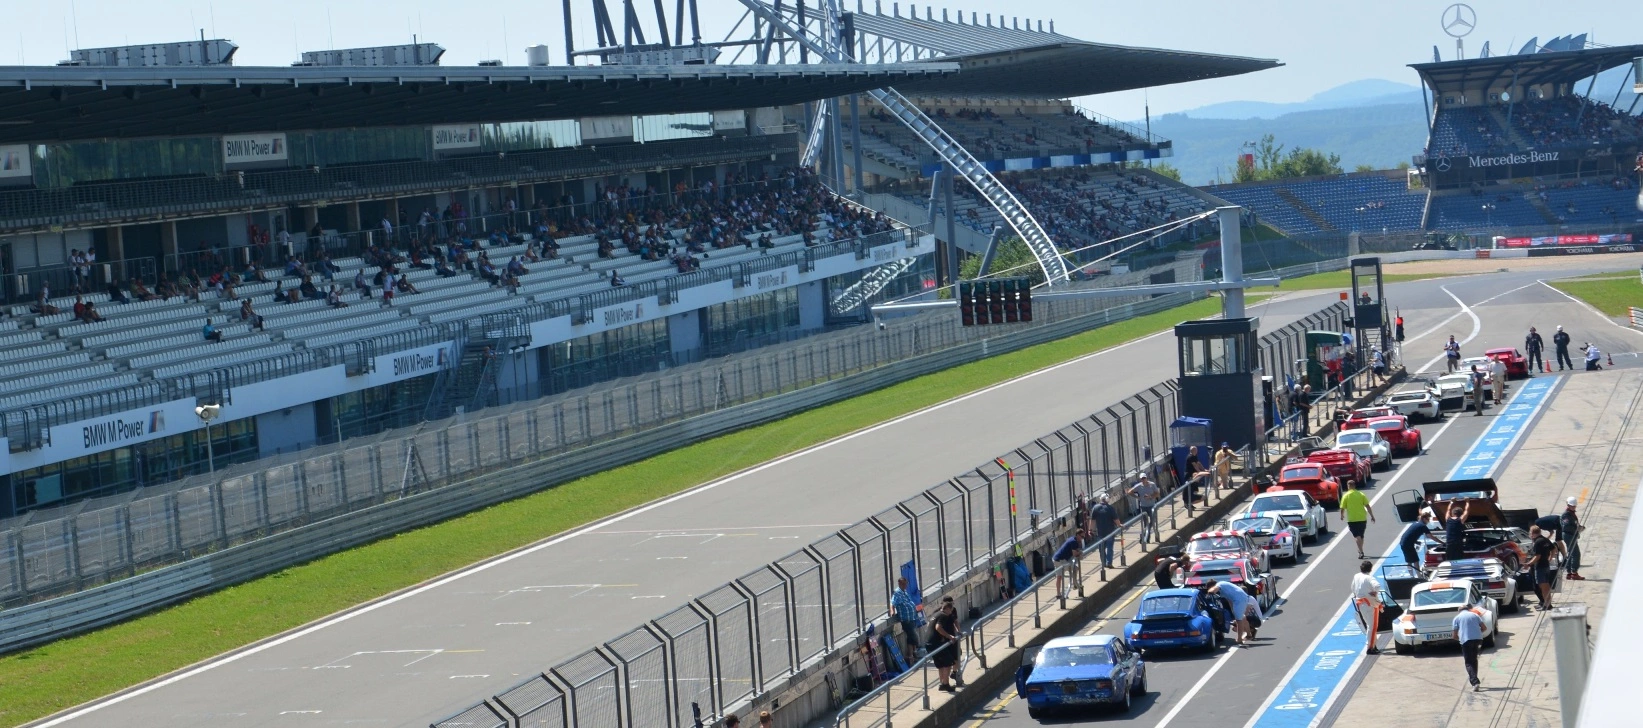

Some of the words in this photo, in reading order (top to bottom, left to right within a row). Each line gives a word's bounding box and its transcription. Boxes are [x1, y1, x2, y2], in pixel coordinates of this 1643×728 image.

[436, 130, 448, 144] BMW
[454, 129, 467, 143] Power
[227, 140, 243, 157] BMW
[244, 140, 250, 156] M
[251, 139, 270, 156] Power
[1469, 151, 1559, 168] Mercedes-Benz
[394, 355, 410, 376] BMW
[410, 354, 416, 372] M
[416, 353, 434, 370] Power
[83, 422, 107, 448] BMW
[108, 421, 117, 443] M
[118, 419, 144, 441] Power
